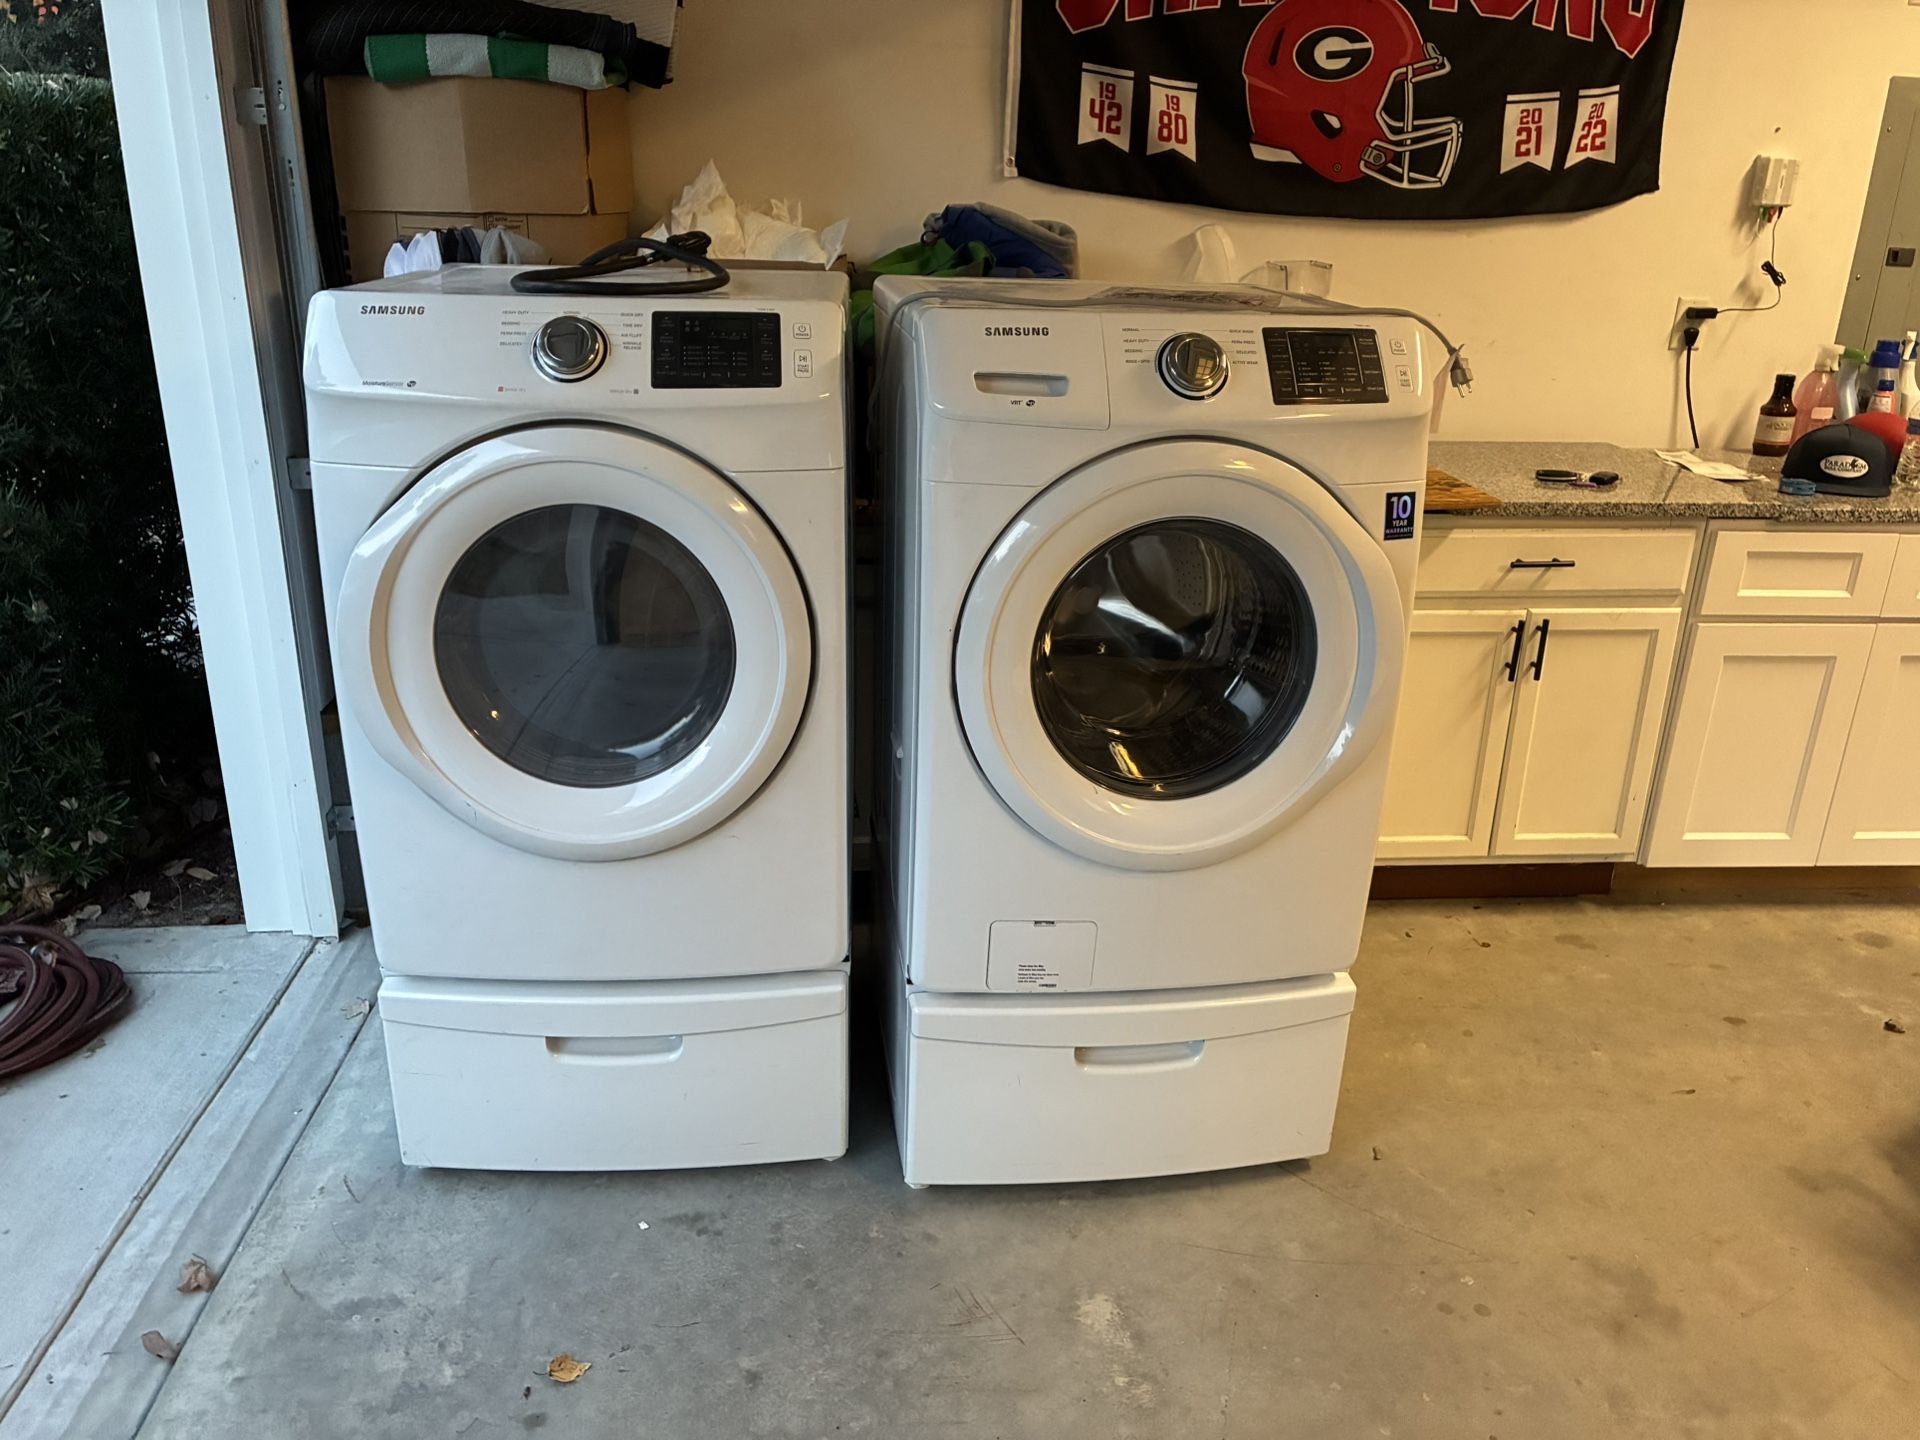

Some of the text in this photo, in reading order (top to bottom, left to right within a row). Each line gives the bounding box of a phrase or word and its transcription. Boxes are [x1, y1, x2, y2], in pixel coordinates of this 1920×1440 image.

[1293, 25, 1374, 82] G
[1098, 81, 1117, 101] 19
[1164, 93, 1181, 113] 19
[1588, 101, 1606, 121] 20
[1088, 98, 1123, 136] 42
[1519, 107, 1543, 126] 20
[1157, 109, 1189, 146] 80
[1574, 119, 1608, 154] 22
[1514, 125, 1543, 158] 21
[360, 305, 426, 316] SAMSUNG
[984, 326, 1050, 337] SAMSUNG
[1390, 495, 1412, 519] 10
[1385, 526, 1414, 534] WARRANTY
[1392, 519, 1408, 527] YEAR
